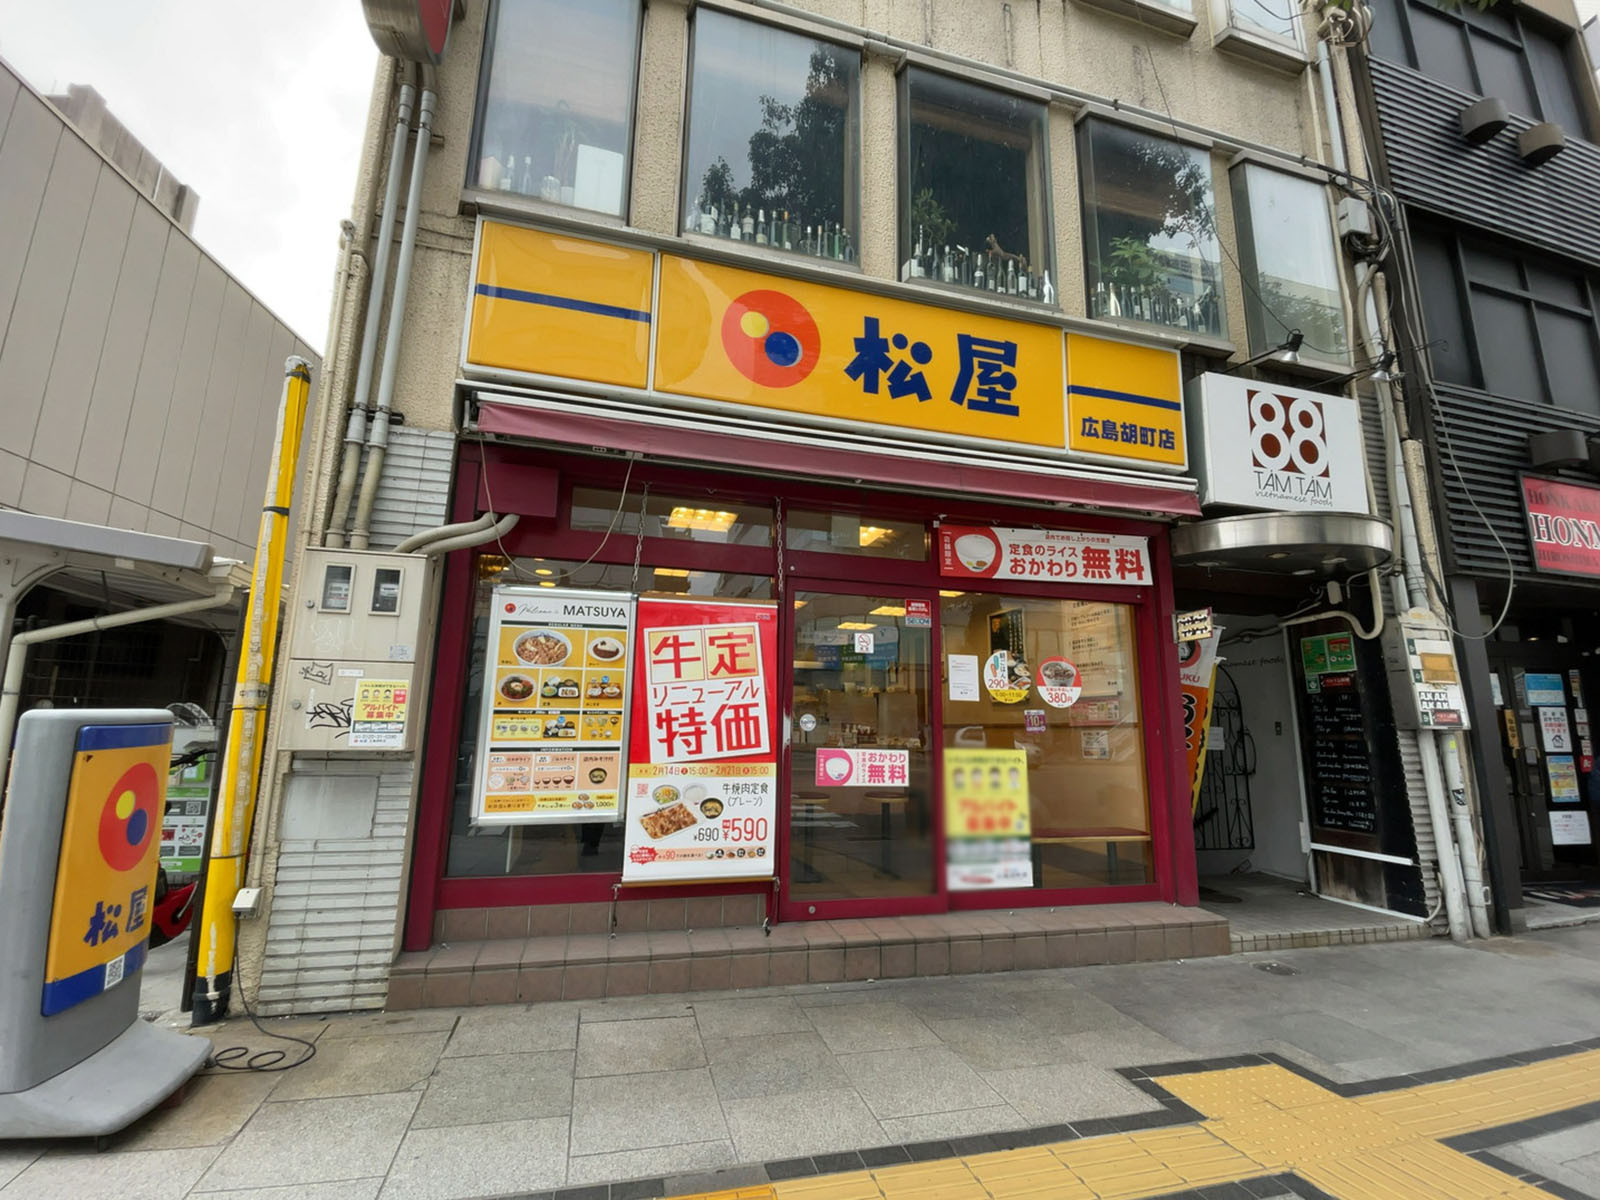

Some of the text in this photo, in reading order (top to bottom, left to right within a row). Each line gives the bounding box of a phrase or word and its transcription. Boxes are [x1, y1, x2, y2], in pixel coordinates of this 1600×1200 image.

[843, 316, 1020, 417] 松屋
[1081, 417, 1176, 451] 広島胡町店
[1250, 390, 1330, 477] 88
[1008, 543, 1079, 559] 定食のライス
[1080, 545, 1145, 581] 無料
[1009, 557, 1079, 578] おかわり
[563, 604, 627, 619] MATSUYA
[652, 632, 757, 679] 牛定
[362, 703, 399, 712] アルバイト
[653, 678, 760, 708] リニューアル
[655, 702, 762, 758] 特価
[867, 752, 907, 763] おかわり
[722, 782, 769, 795] 牛焼肉定食
[867, 763, 907, 785] 無料
[83, 885, 148, 948] 松屋
